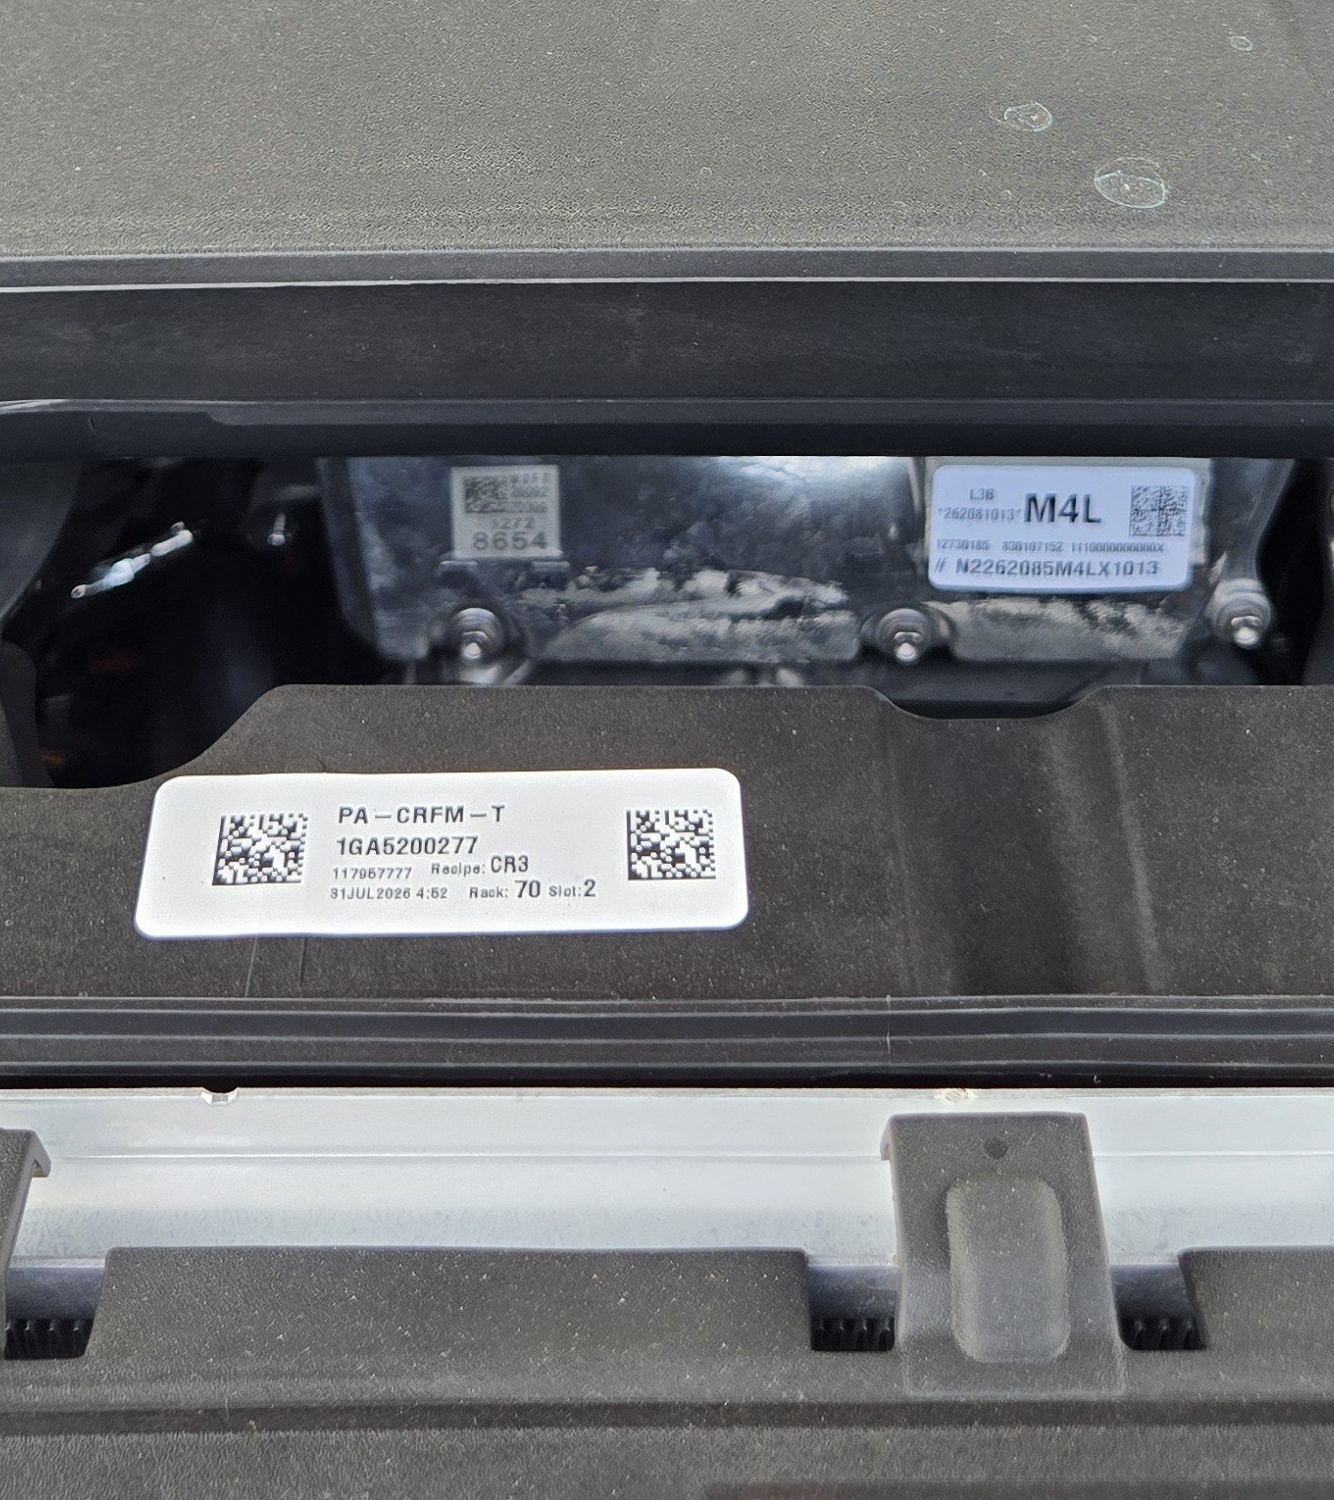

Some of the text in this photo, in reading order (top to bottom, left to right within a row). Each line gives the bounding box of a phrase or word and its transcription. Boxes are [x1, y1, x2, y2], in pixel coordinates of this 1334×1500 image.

[969, 487, 995, 501] L3B
[1023, 492, 1102, 525] M4L
[472, 530, 547, 550] 8654
[955, 558, 1159, 576] N2262085M4LX1013
[336, 834, 479, 856] 1GA5200277
[430, 861, 486, 877] Recipe:
[490, 855, 529, 873] CR3
[330, 886, 411, 900] 31JUL2026
[468, 886, 509, 899] Rack:
[514, 879, 542, 899] 70
